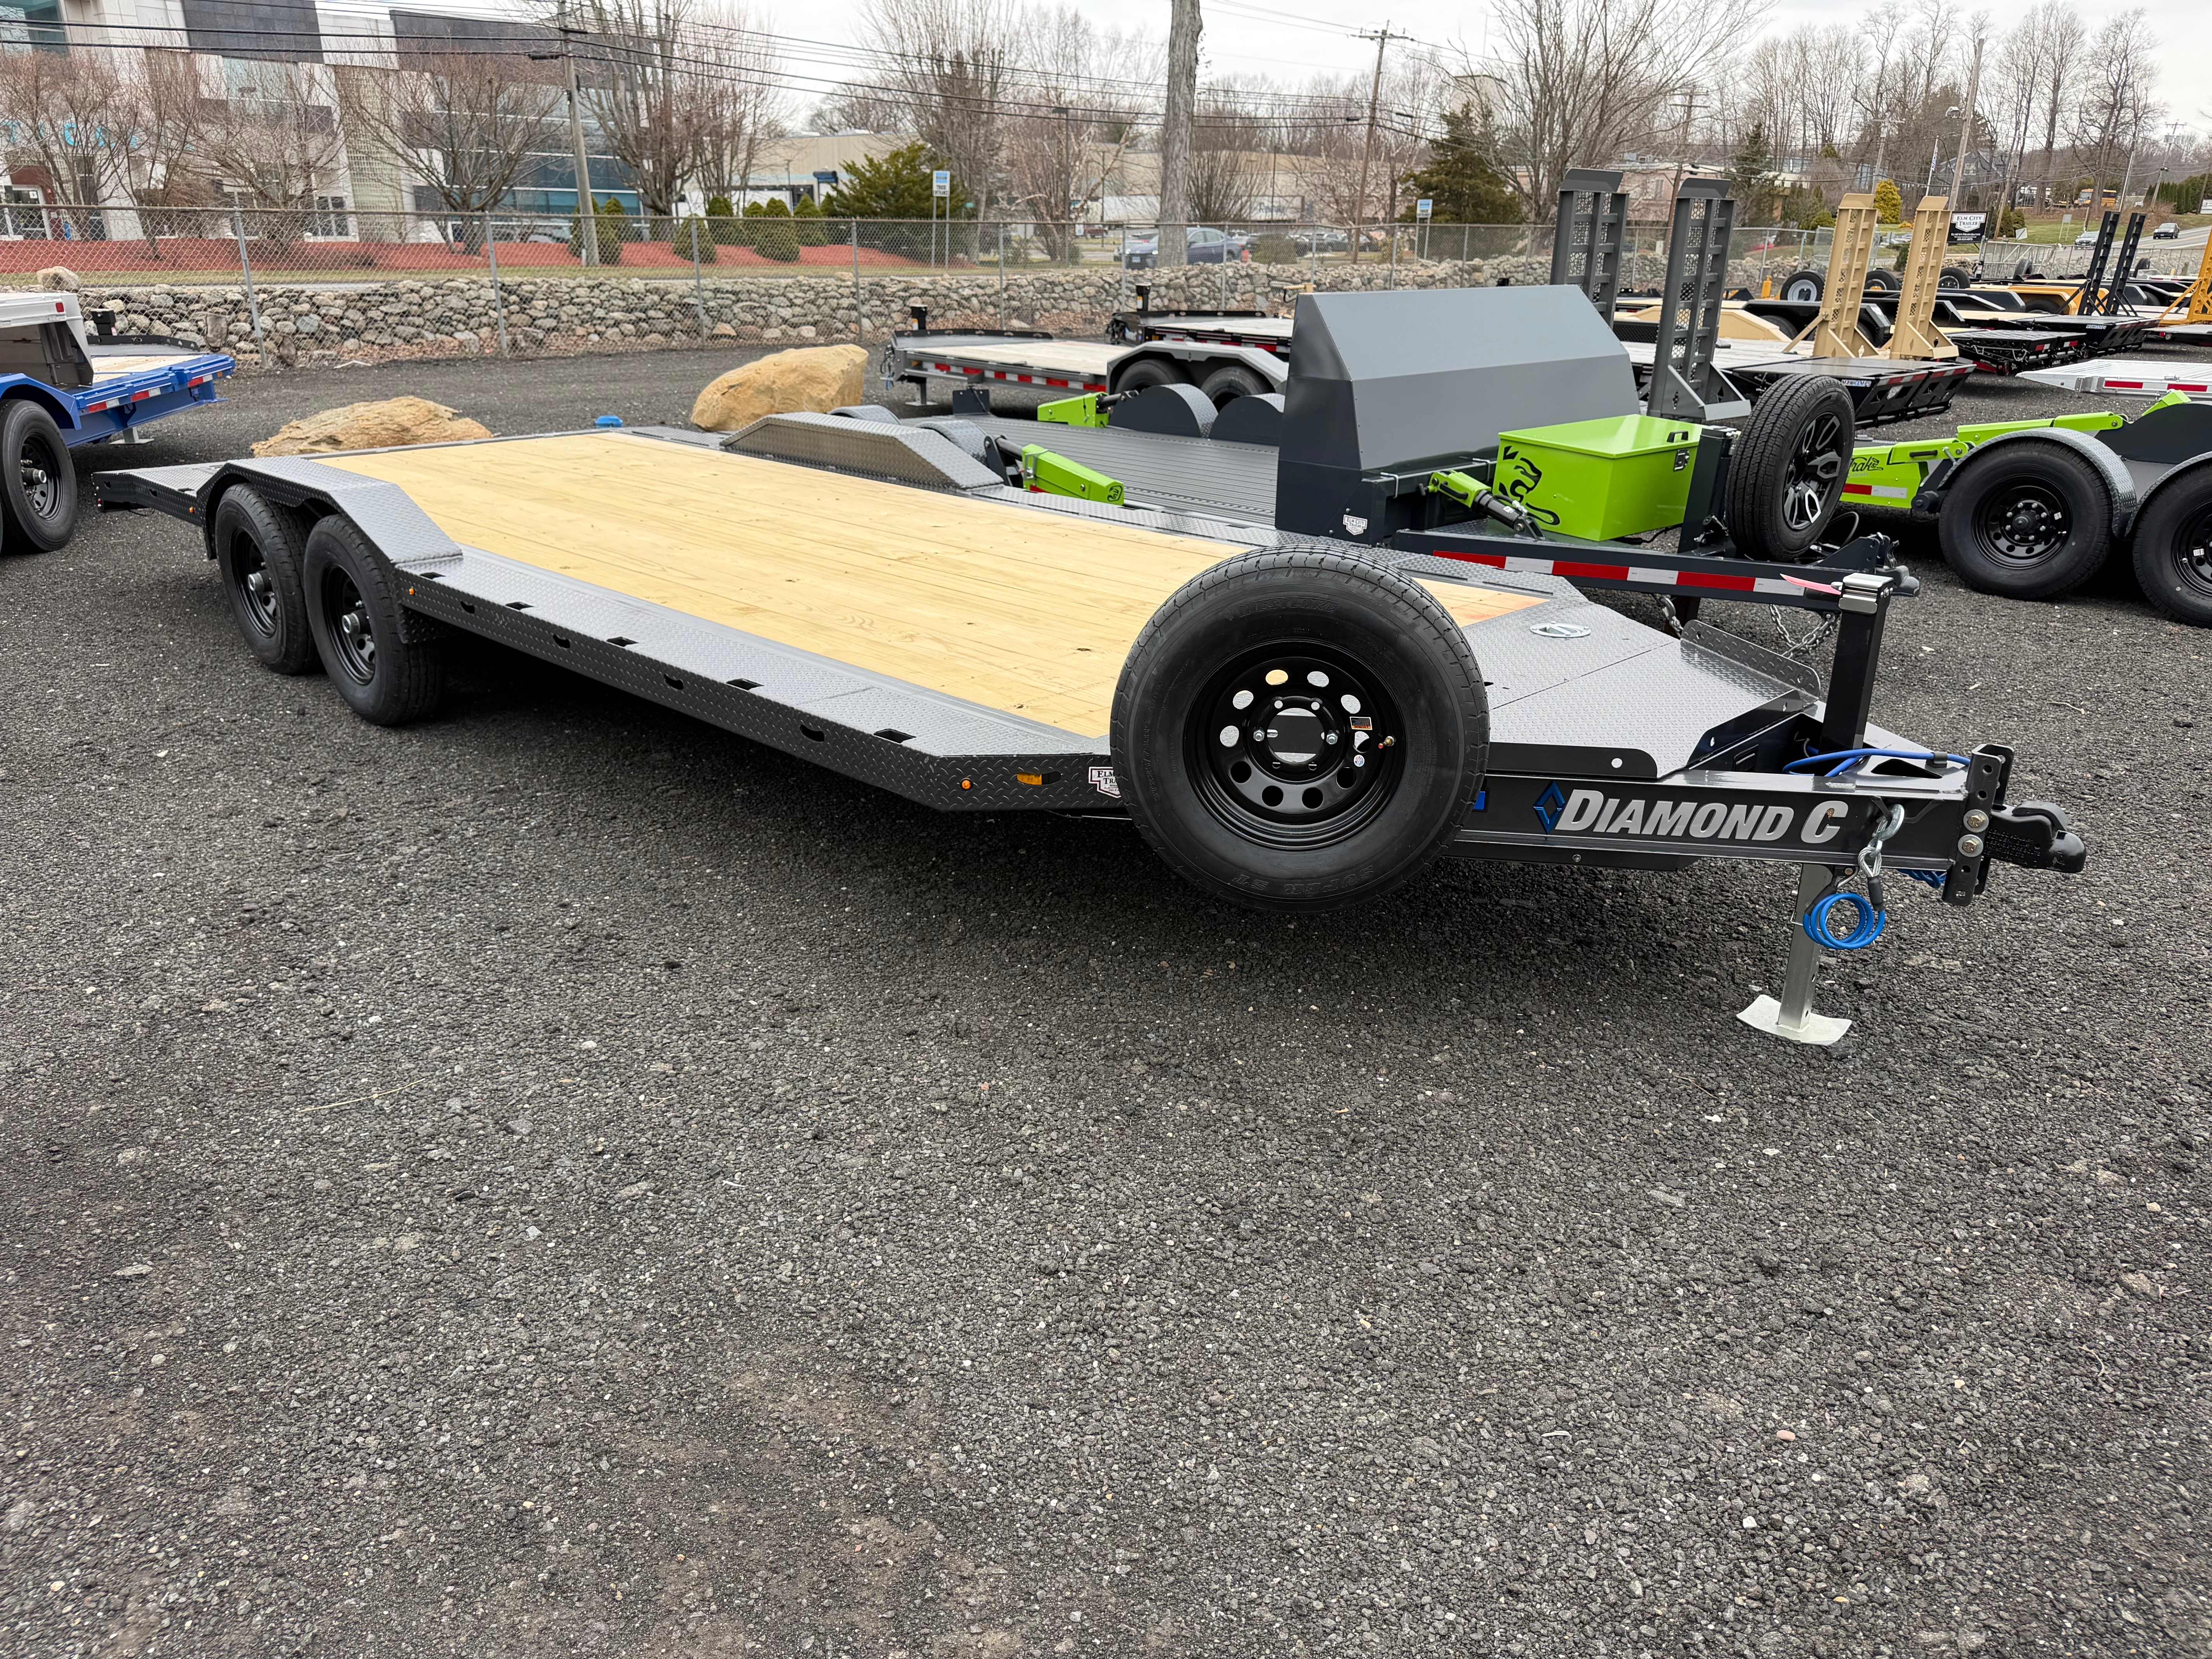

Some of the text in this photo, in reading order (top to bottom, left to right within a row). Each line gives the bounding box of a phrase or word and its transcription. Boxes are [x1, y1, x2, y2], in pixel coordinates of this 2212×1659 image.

[1554, 789, 1849, 844] DIAMOND C
[1232, 874, 1270, 891] ST
[1283, 864, 1374, 895] SUPER
